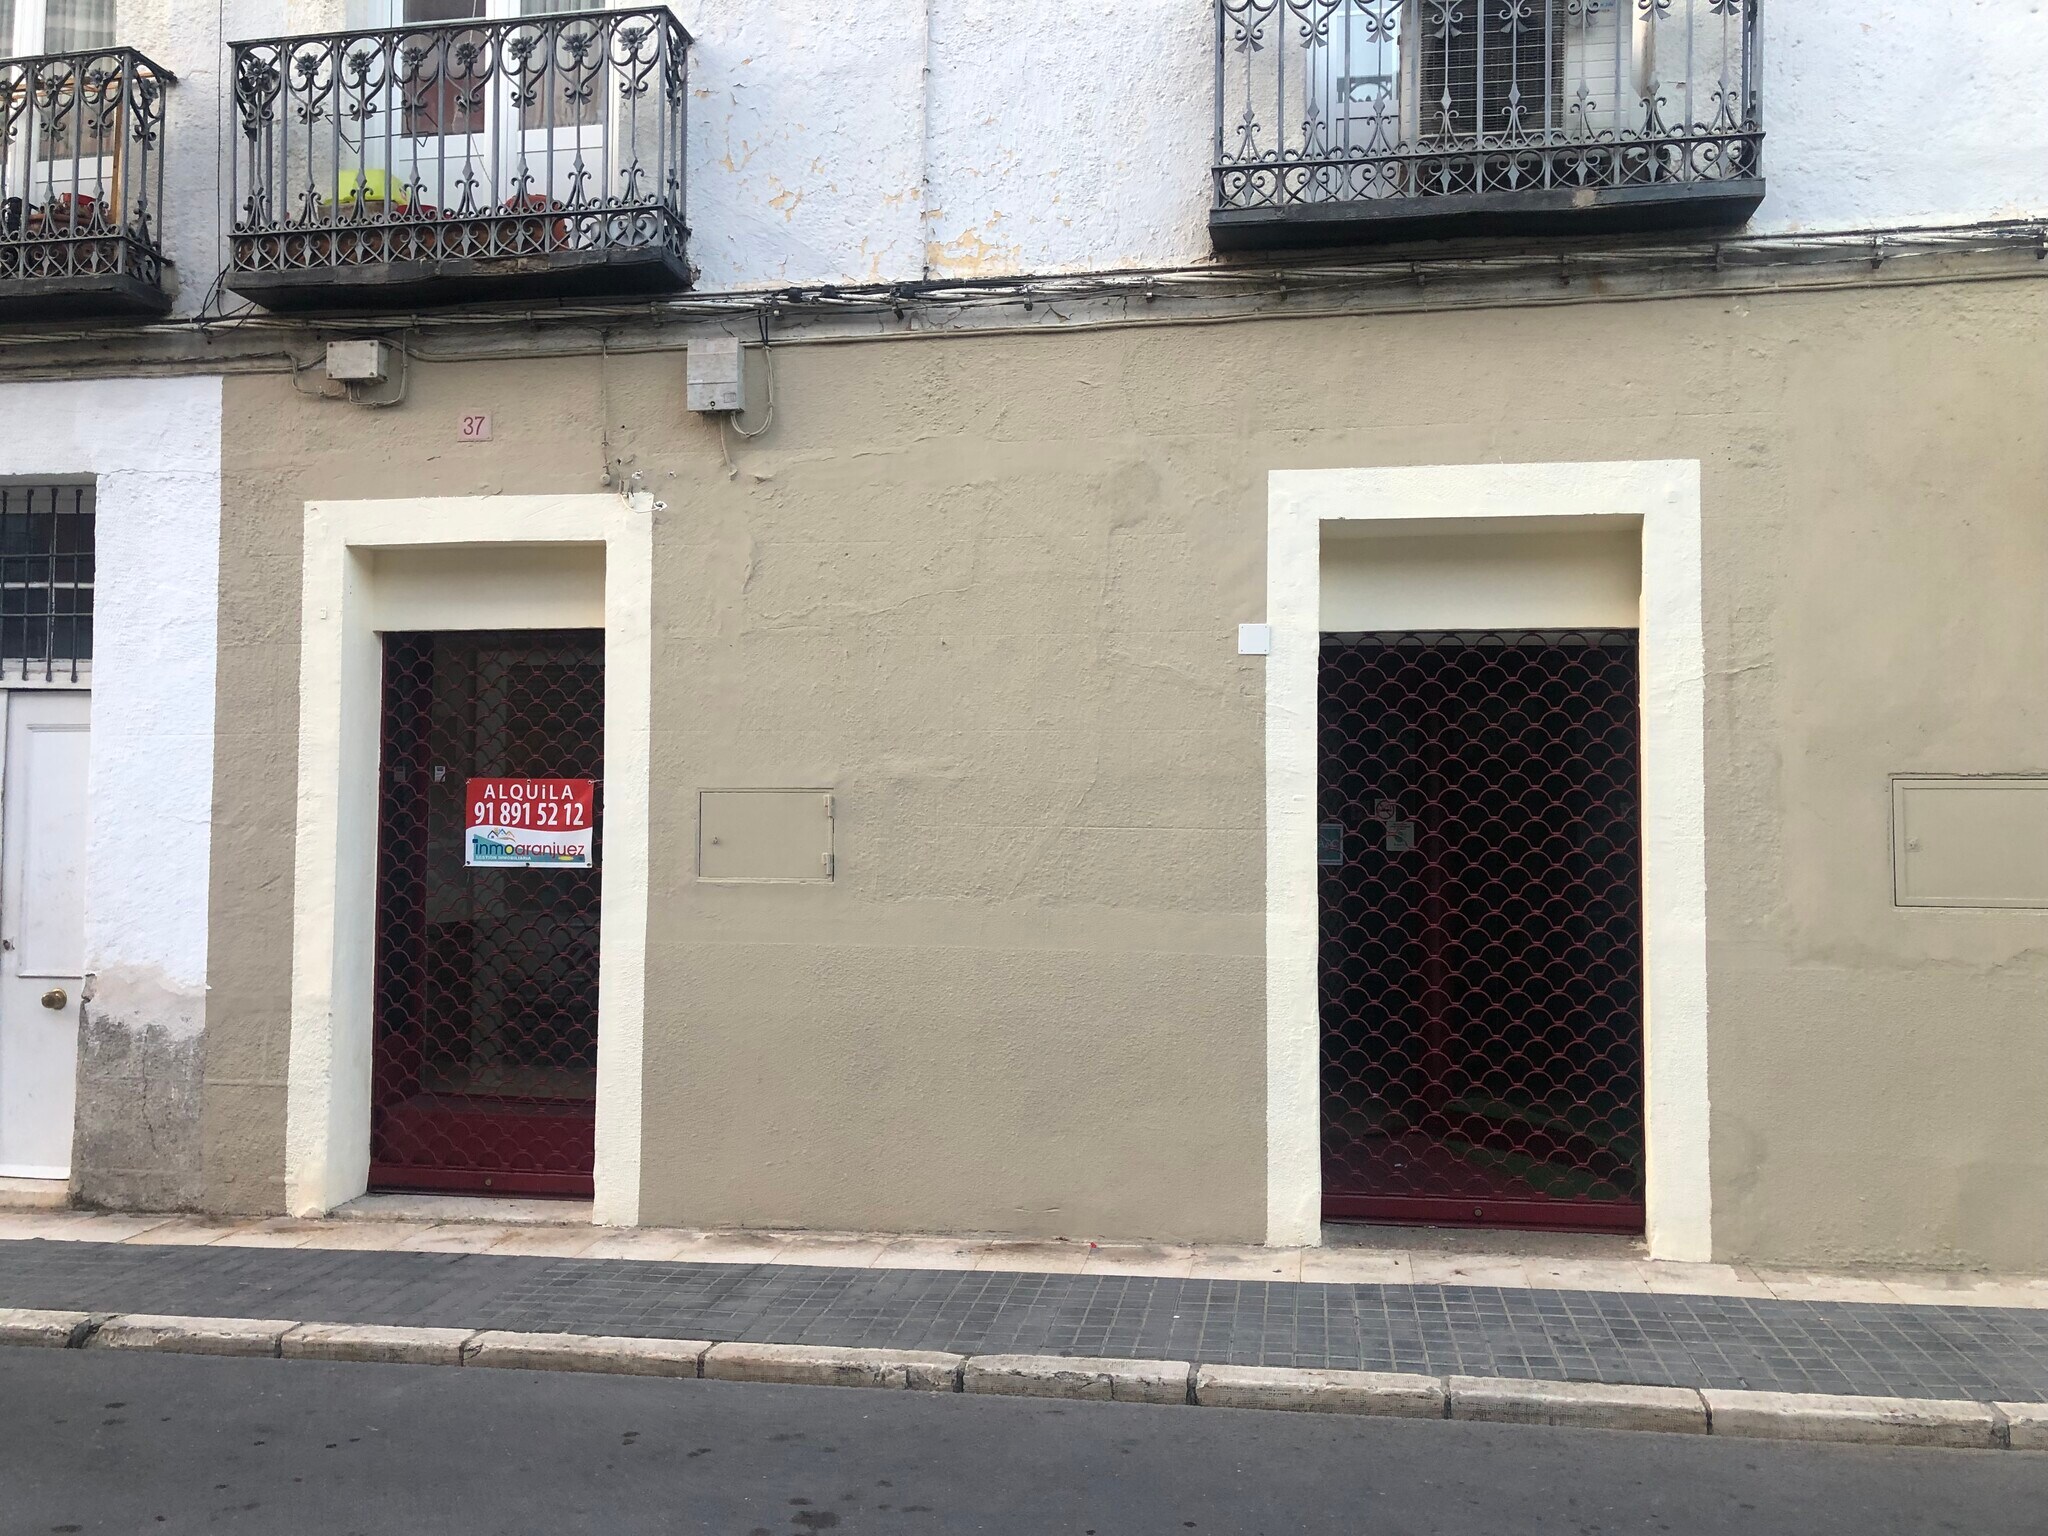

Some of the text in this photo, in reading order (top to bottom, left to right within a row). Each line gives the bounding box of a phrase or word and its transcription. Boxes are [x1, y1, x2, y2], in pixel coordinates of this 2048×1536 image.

[463, 416, 485, 436] 37
[474, 802, 584, 826] 91 891 52 12
[472, 839, 584, 858] inmoaranjuez
